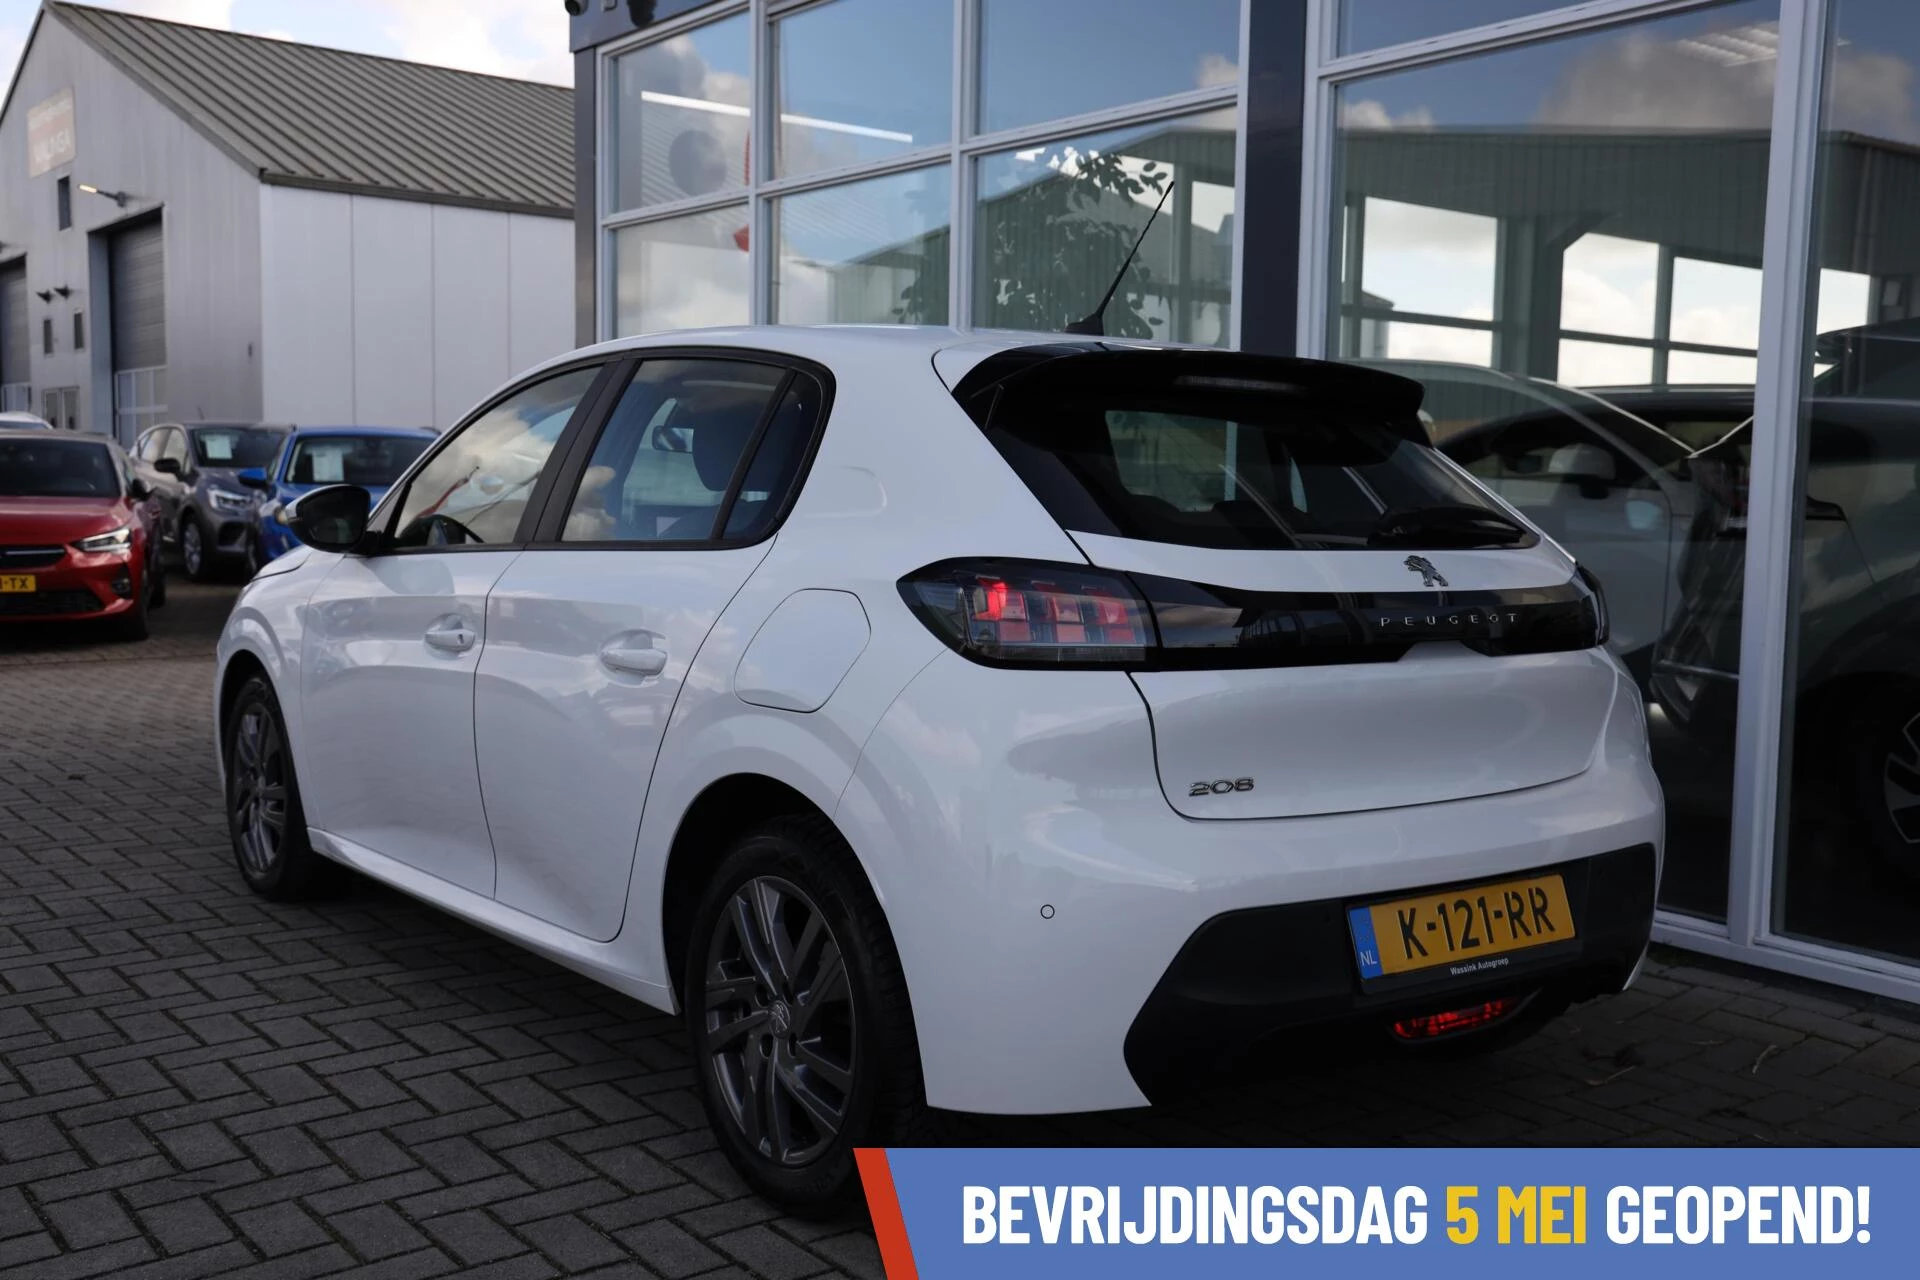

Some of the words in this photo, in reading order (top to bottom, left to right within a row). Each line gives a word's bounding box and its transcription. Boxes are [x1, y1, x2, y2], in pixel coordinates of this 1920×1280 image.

[1380, 613, 1517, 627] PEUGEOT
[1188, 777, 1254, 797] 208
[1397, 887, 1555, 959] K-121-RR
[1360, 949, 1377, 966] NL
[1450, 963, 1477, 975] Wassink
[1478, 957, 1509, 970] Autogroep
